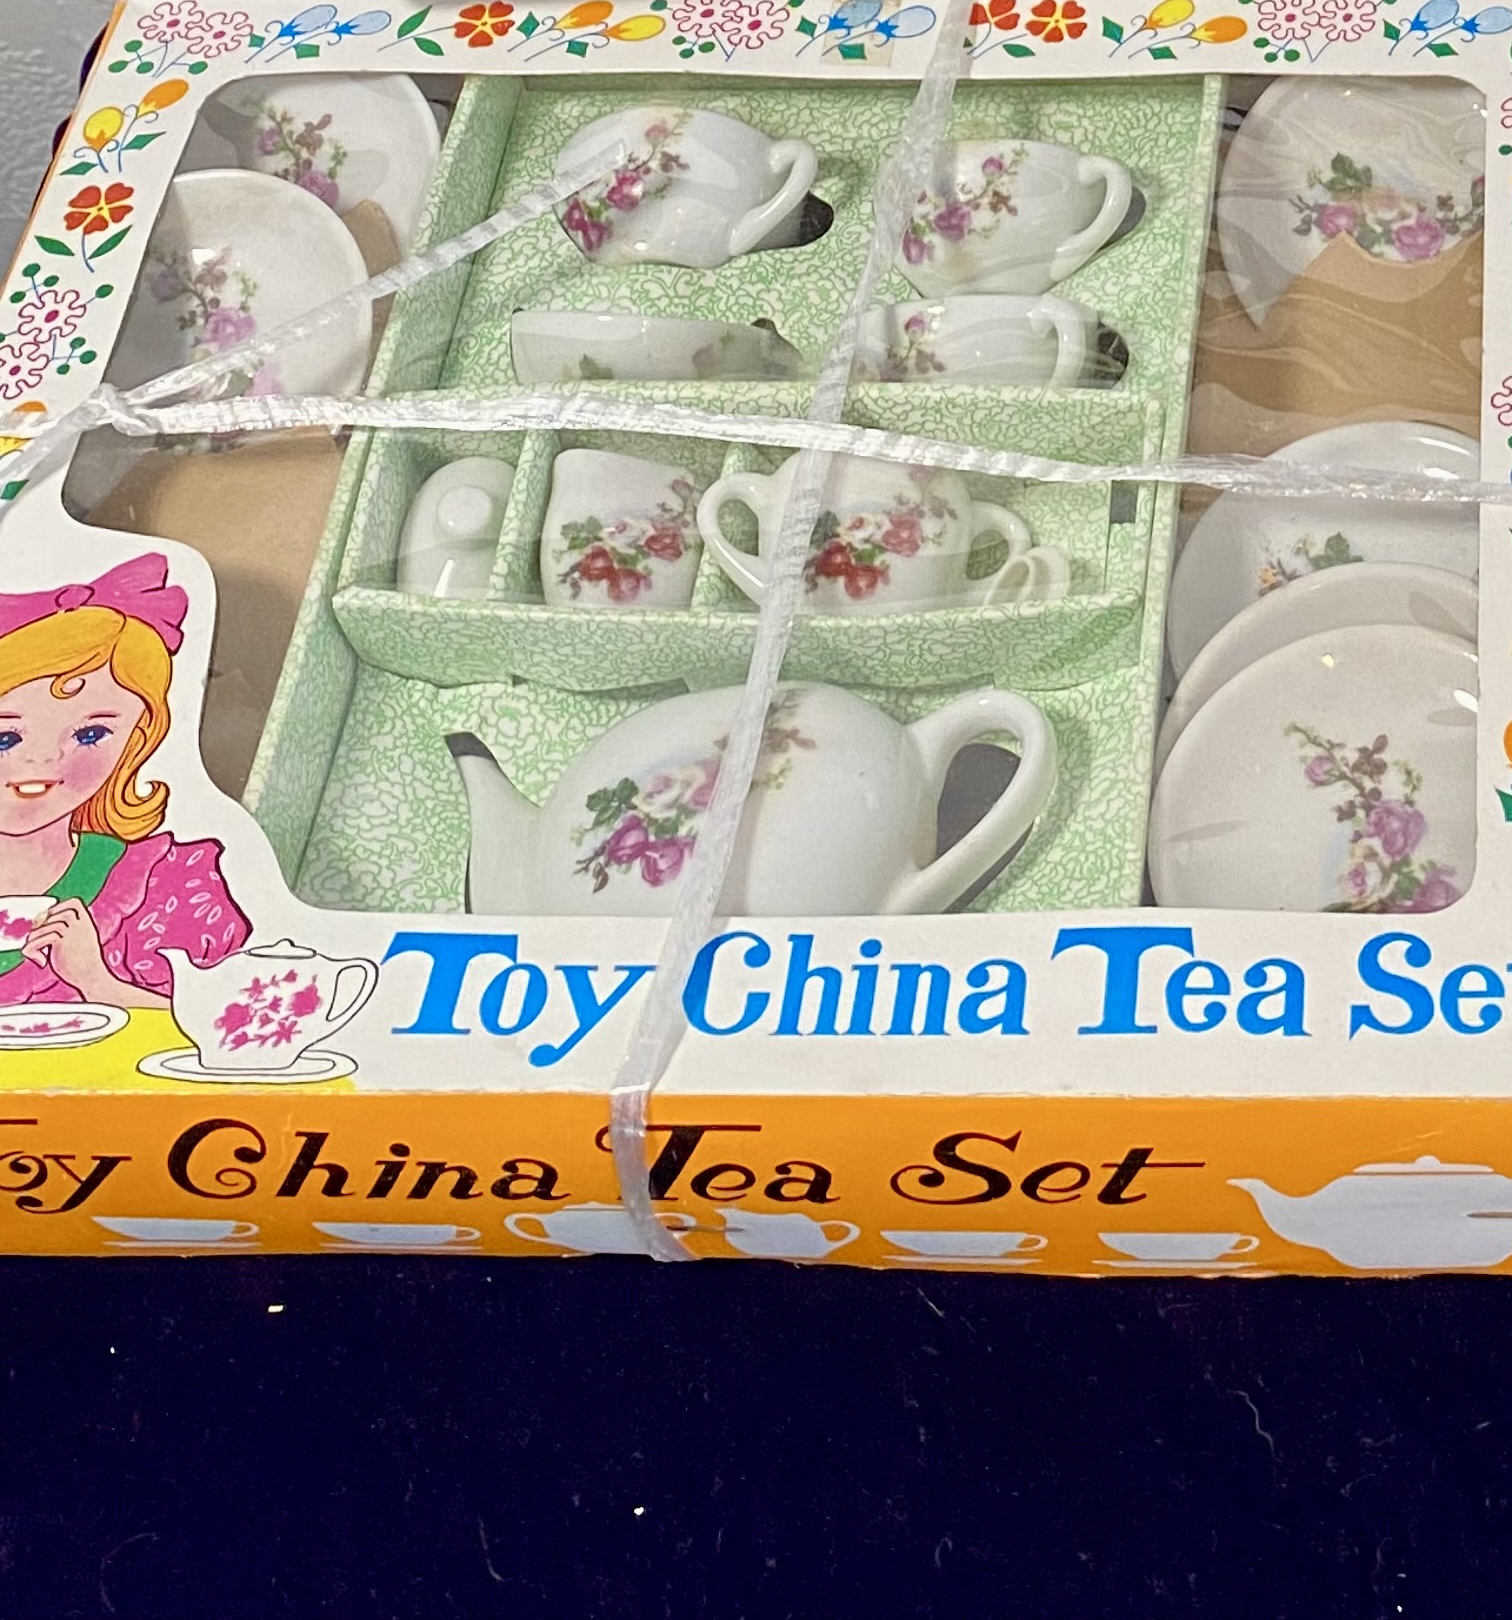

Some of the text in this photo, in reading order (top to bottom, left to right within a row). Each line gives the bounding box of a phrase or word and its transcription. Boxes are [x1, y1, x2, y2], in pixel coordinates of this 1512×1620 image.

[382, 932, 656, 1068] Toy
[682, 931, 1029, 1036] China
[1052, 926, 1307, 1037] Tea
[0, 1118, 1206, 1215] oy China Tea Set
